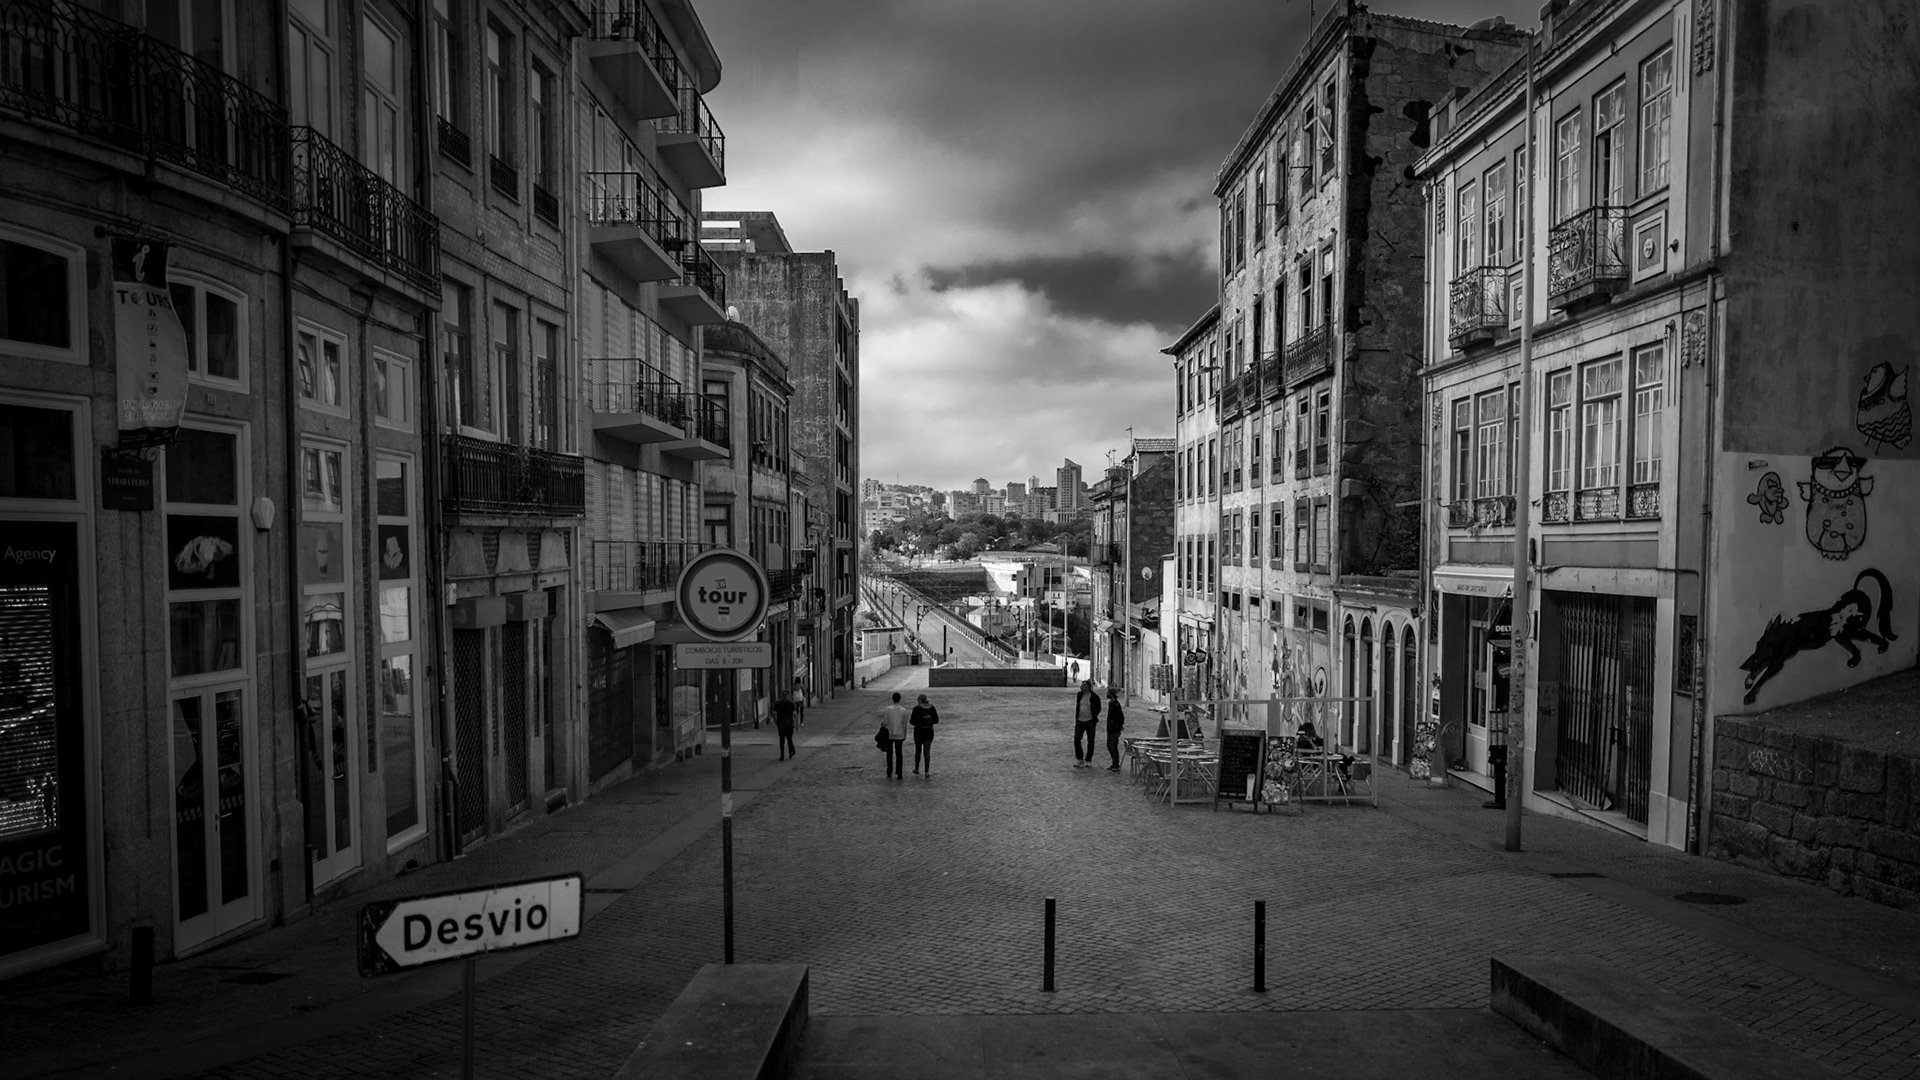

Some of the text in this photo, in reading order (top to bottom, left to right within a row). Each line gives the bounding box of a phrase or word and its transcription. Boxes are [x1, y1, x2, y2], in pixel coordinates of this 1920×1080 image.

[3, 545, 57, 564] Agency
[698, 586, 747, 604] tour
[685, 645, 763, 655] COMBOIOS TURÍSTICOS
[705, 657, 720, 665] DAS
[403, 898, 548, 952] Desvio
